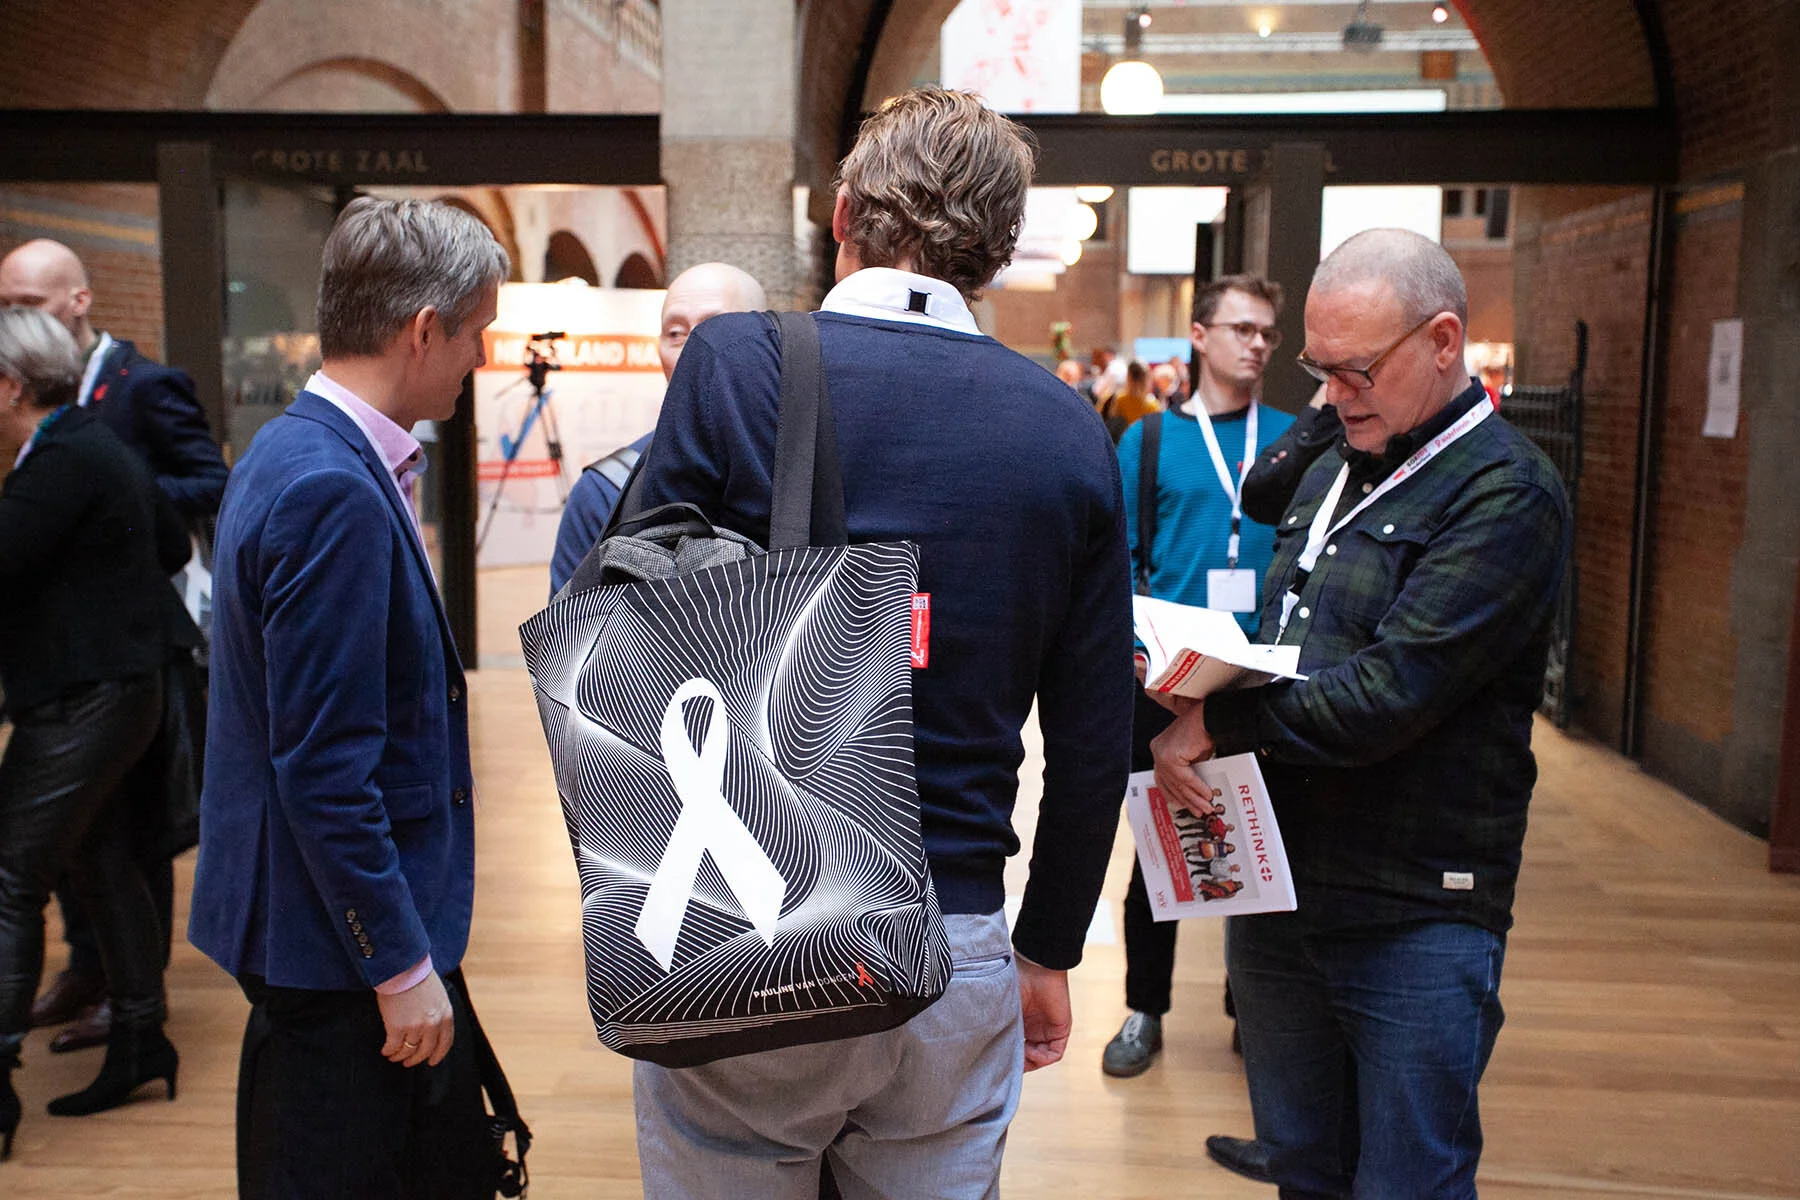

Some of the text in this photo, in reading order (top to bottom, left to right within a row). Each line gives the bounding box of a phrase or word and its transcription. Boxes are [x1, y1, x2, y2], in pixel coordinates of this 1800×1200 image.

[356, 149, 430, 173] ZAAL
[1150, 149, 1338, 172] GROTE ZL
[753, 972, 856, 998] PAULINE VAN DONGEN
